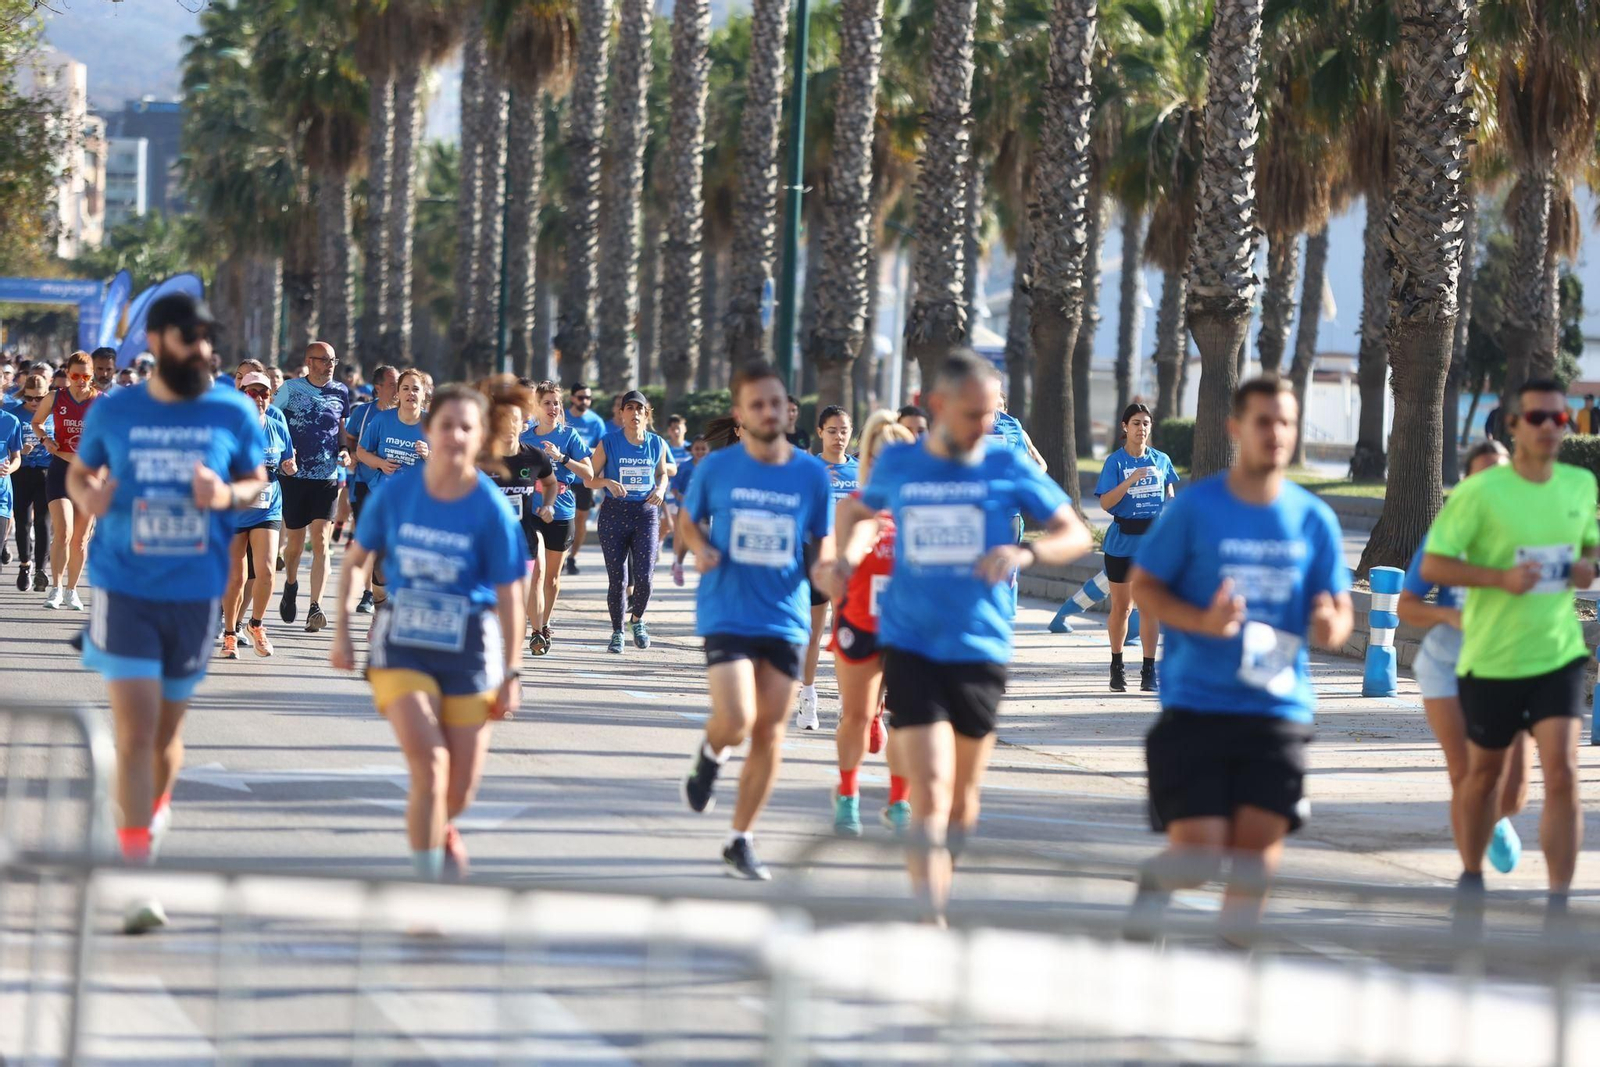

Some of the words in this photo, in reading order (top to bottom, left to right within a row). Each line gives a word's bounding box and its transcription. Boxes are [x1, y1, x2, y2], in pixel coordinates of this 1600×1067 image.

[60, 406, 67, 415] 3
[385, 437, 416, 448] mayor
[618, 457, 653, 466] mayoral
[630, 476, 643, 484] 92
